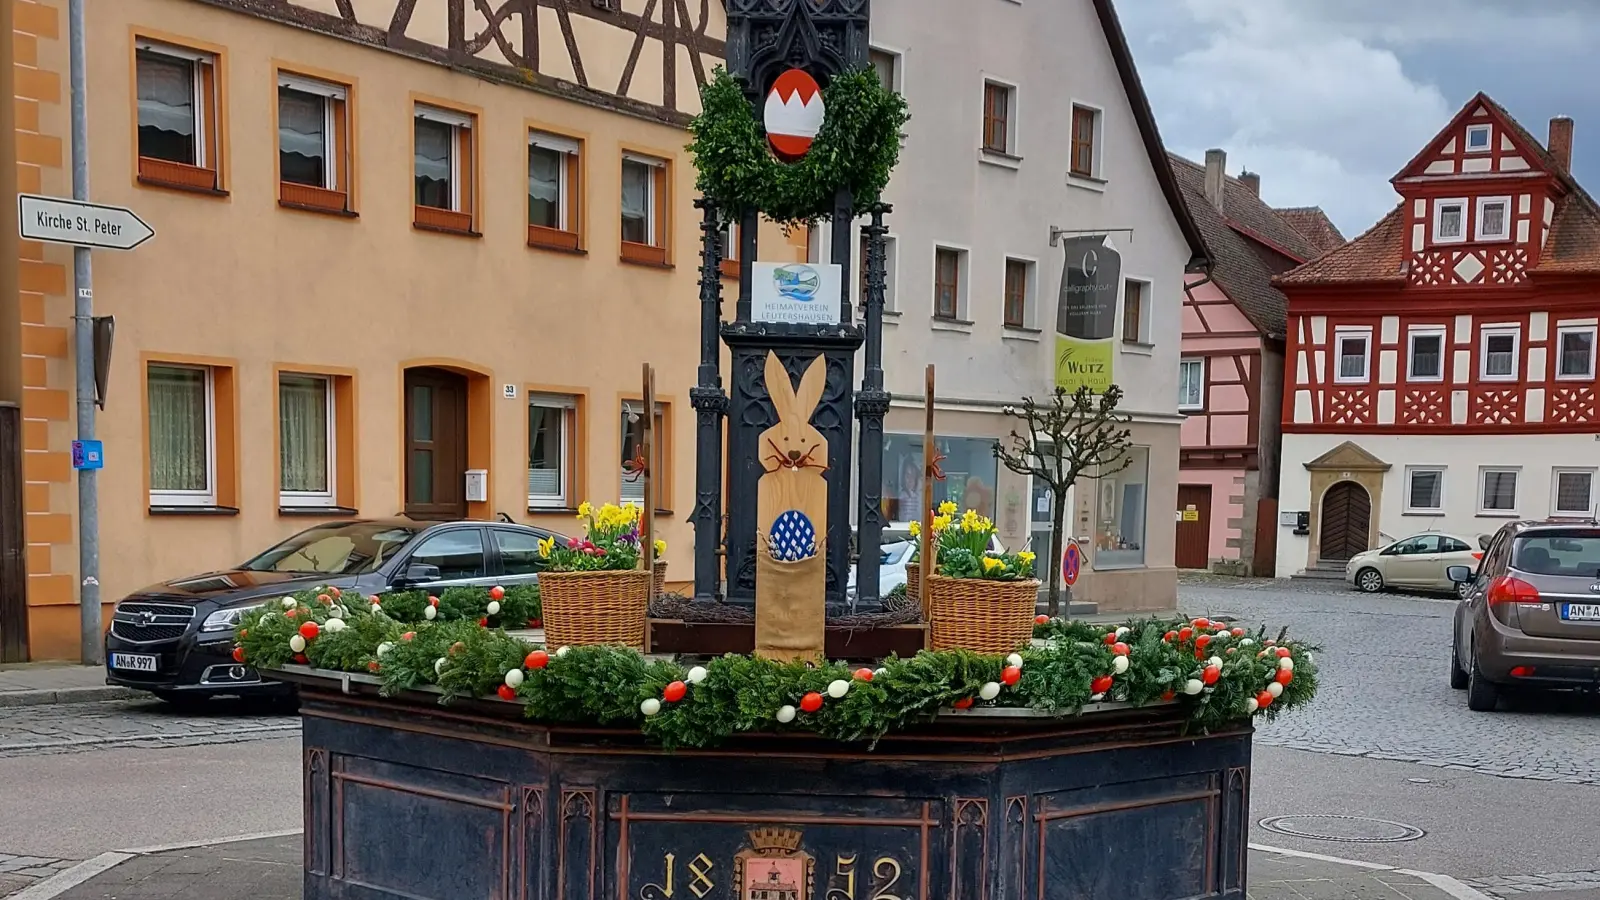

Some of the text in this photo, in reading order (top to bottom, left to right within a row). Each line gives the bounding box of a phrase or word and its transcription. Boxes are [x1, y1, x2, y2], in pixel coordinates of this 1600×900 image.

[36, 211, 122, 236] Kirche St. Peter
[765, 302, 829, 312] HEIMATVEREIN
[761, 312, 833, 321] LEUTERSHAUSEN
[1088, 375, 1106, 385] Haut
[505, 385, 514, 394] 33
[1570, 605, 1585, 617] AN
[116, 654, 126, 668] AN
[137, 656, 152, 670] 997
